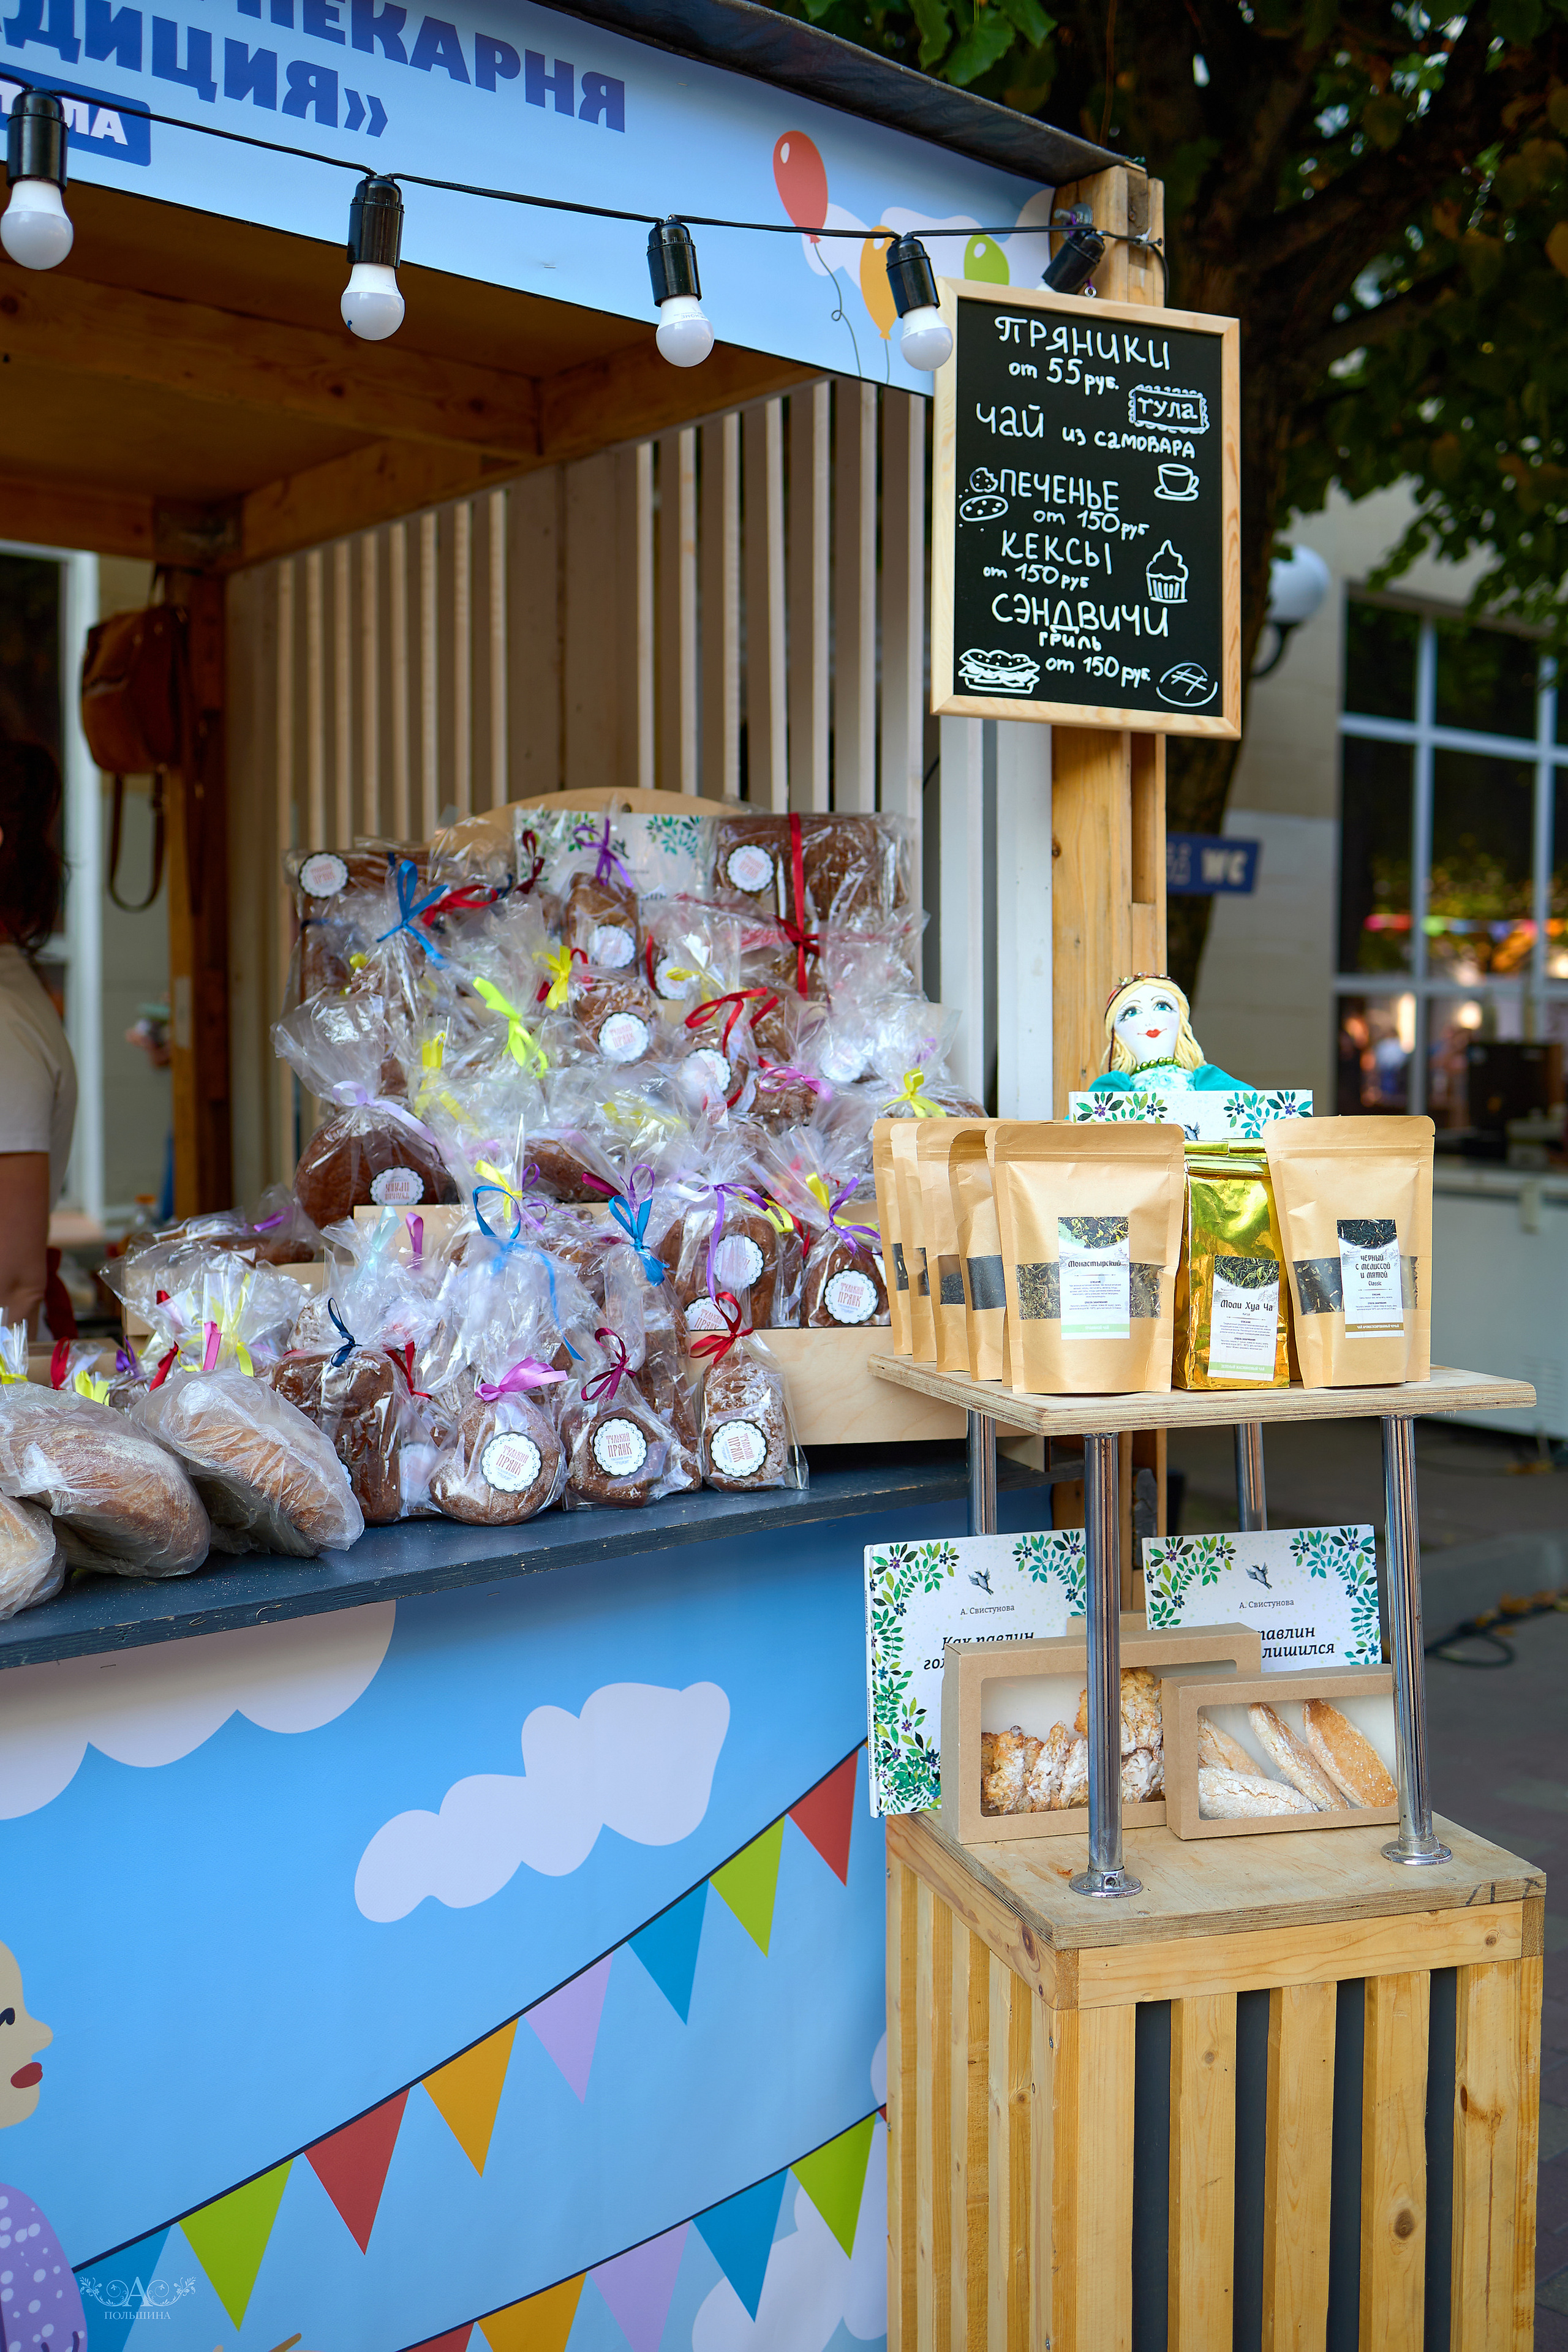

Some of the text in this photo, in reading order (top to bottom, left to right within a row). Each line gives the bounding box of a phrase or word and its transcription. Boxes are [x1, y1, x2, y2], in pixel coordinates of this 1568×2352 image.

[0, 0, 388, 137] ДИЦИЯ»
[0, 80, 128, 145] ТЛА
[995, 316, 1170, 371] ПРЯНИКИ
[1009, 358, 1119, 396] от 55 руб.
[1137, 396, 1198, 420] тула
[1062, 427, 1086, 446] из
[1000, 469, 1119, 512] ПЕЧЕНЬЕ
[1033, 510, 1150, 541] от 150 руб
[1001, 530, 1112, 575] КЕКСЫ
[983, 563, 1090, 591] от 150 руб
[992, 593, 1168, 638] СЭНДВИЧИ
[1045, 656, 1151, 688] от 150 руб.
[1202, 848, 1248, 886] WC
[1221, 1300, 1242, 1309] Моли
[1245, 1302, 1260, 1311] Хуа
[970, 1605, 1015, 1614] Свистунова
[1248, 1599, 1294, 1609] Свистунова
[1262, 1643, 1335, 1659] лишился
